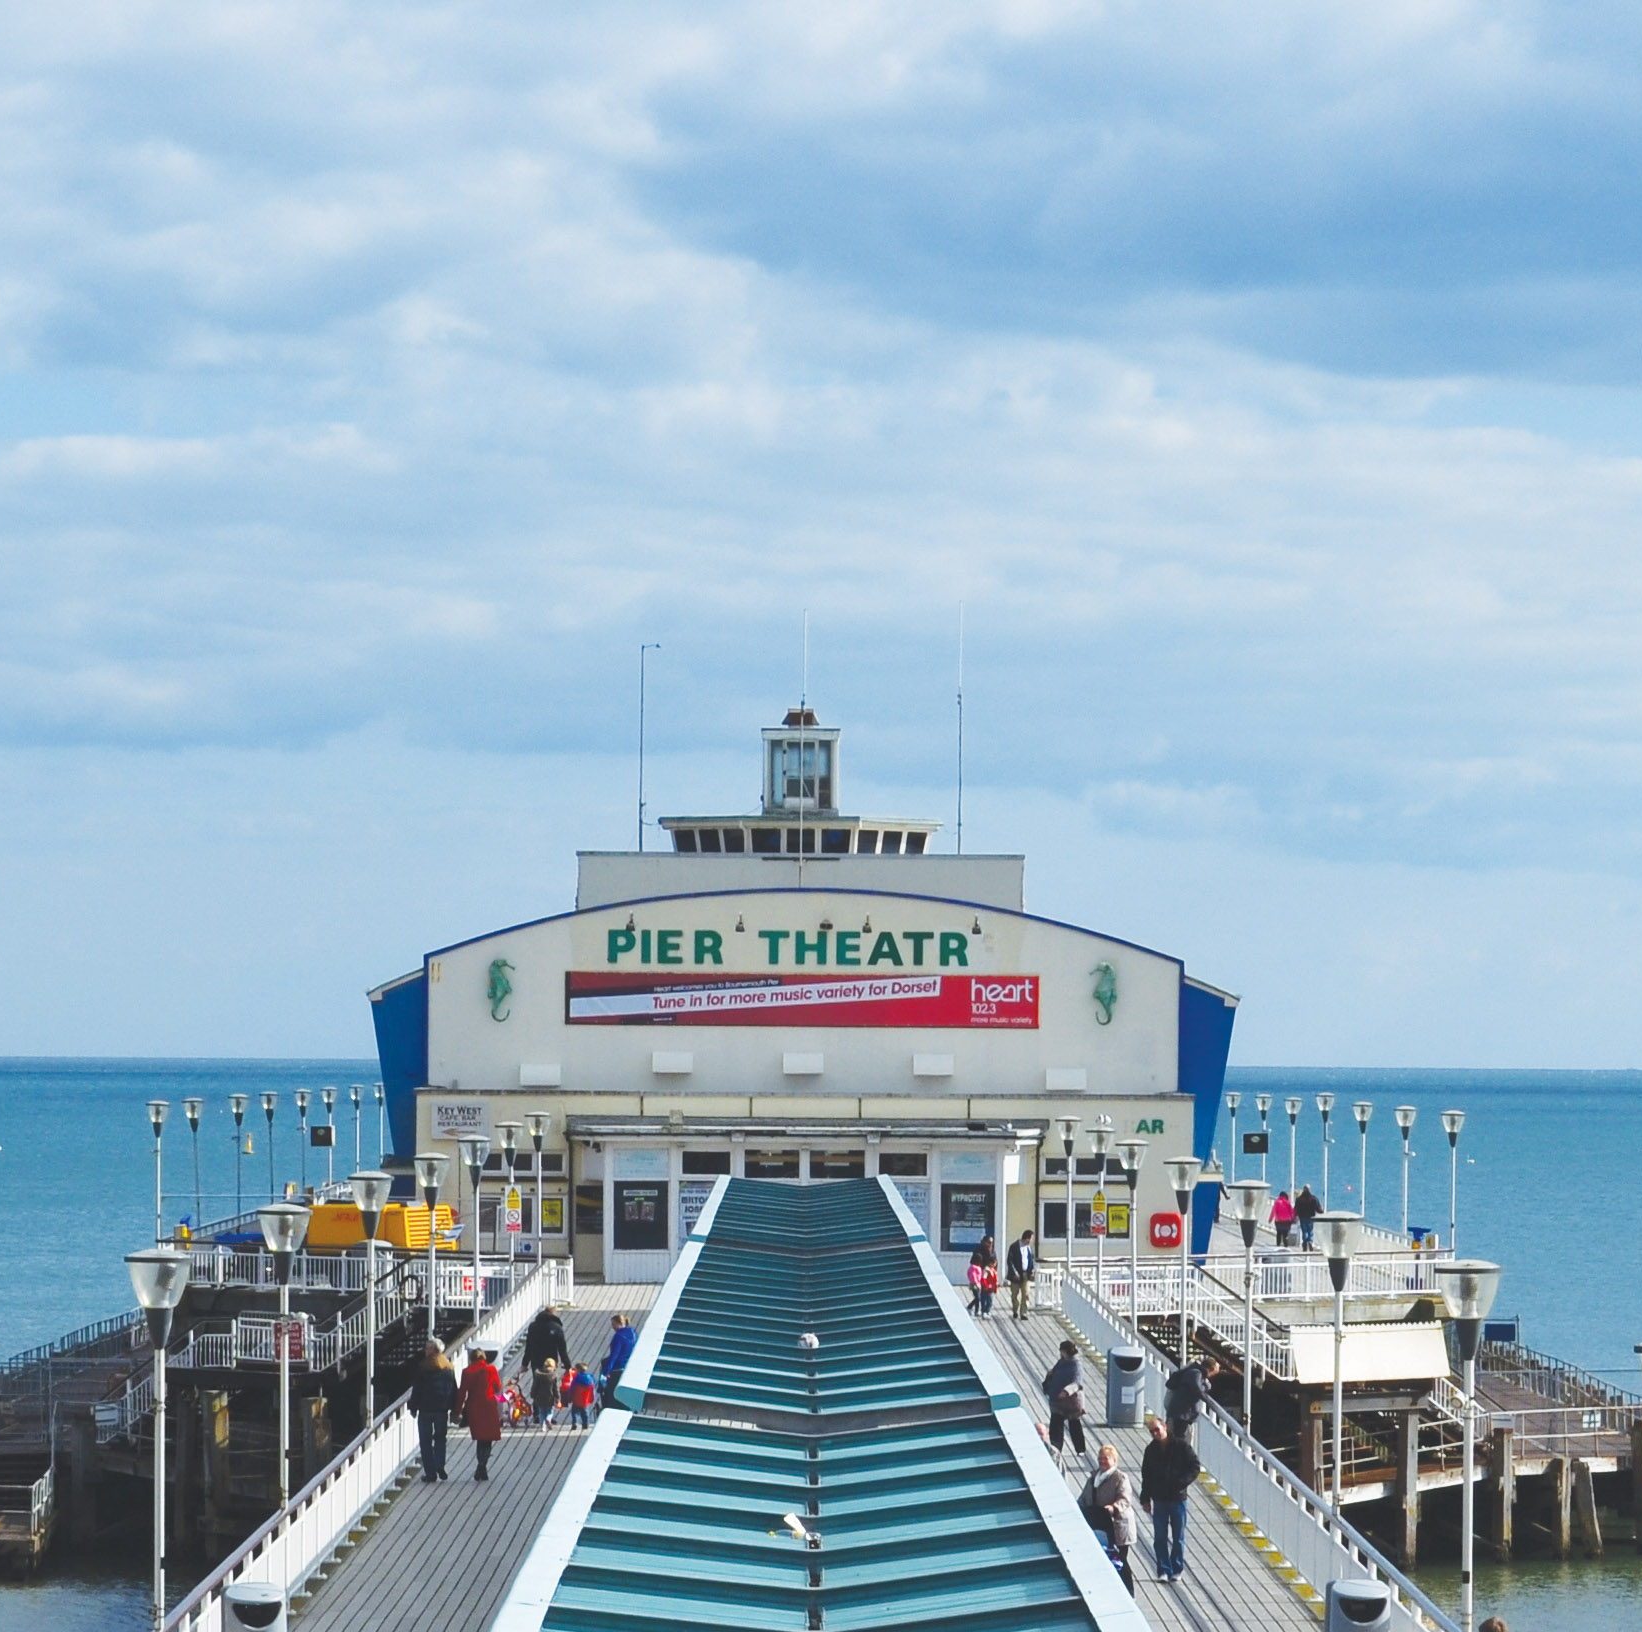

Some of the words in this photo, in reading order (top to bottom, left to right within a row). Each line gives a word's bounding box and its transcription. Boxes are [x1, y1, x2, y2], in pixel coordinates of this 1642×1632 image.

[607, 929, 723, 965] PIER
[758, 930, 969, 967] THEATR
[653, 996, 686, 1009] Tune
[689, 994, 702, 1008] in
[706, 992, 725, 1006] for
[729, 990, 766, 1004] more
[770, 988, 812, 1002] music
[817, 983, 864, 1000] variety
[868, 981, 887, 996] for
[891, 979, 938, 995] Dorset
[971, 978, 1033, 1003] heart
[971, 1002, 997, 1014] 102.3
[437, 1106, 455, 1115] KEY
[457, 1106, 482, 1115] WEST
[1135, 1119, 1164, 1134] AR
